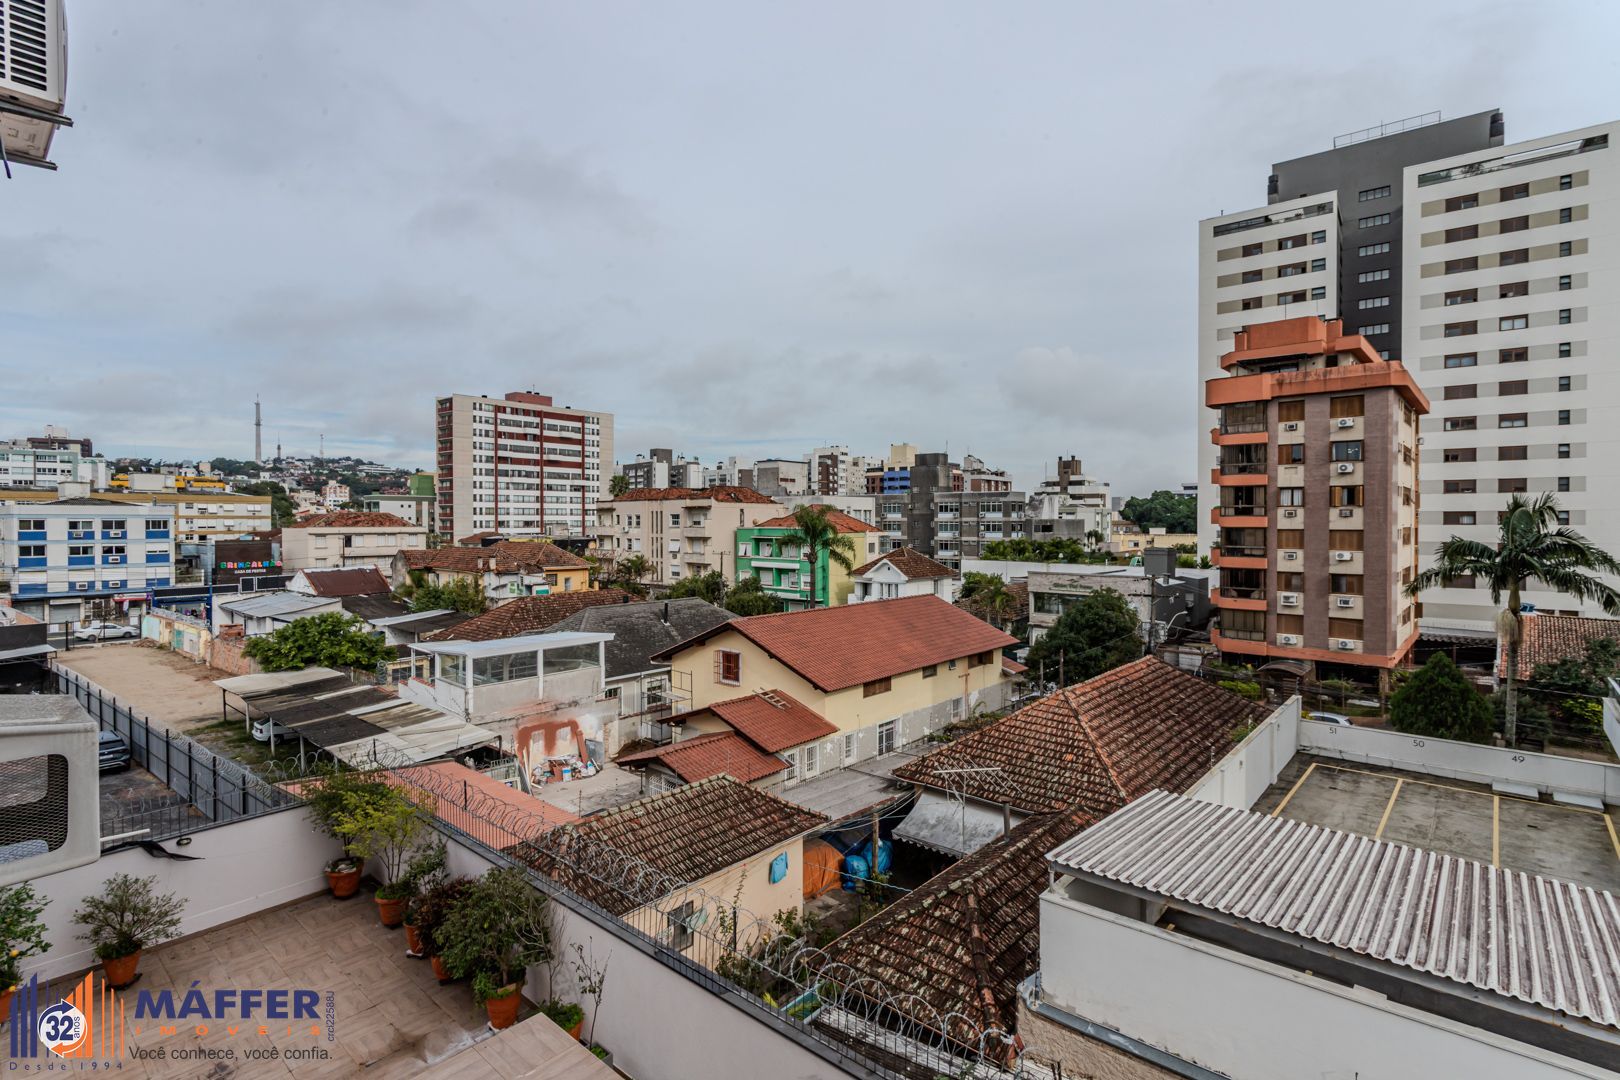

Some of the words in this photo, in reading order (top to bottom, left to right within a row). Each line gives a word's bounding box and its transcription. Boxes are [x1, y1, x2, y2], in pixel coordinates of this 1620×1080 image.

[1329, 727, 1337, 735] 51
[1413, 740, 1425, 748] 50
[1511, 755, 1525, 763] 49
